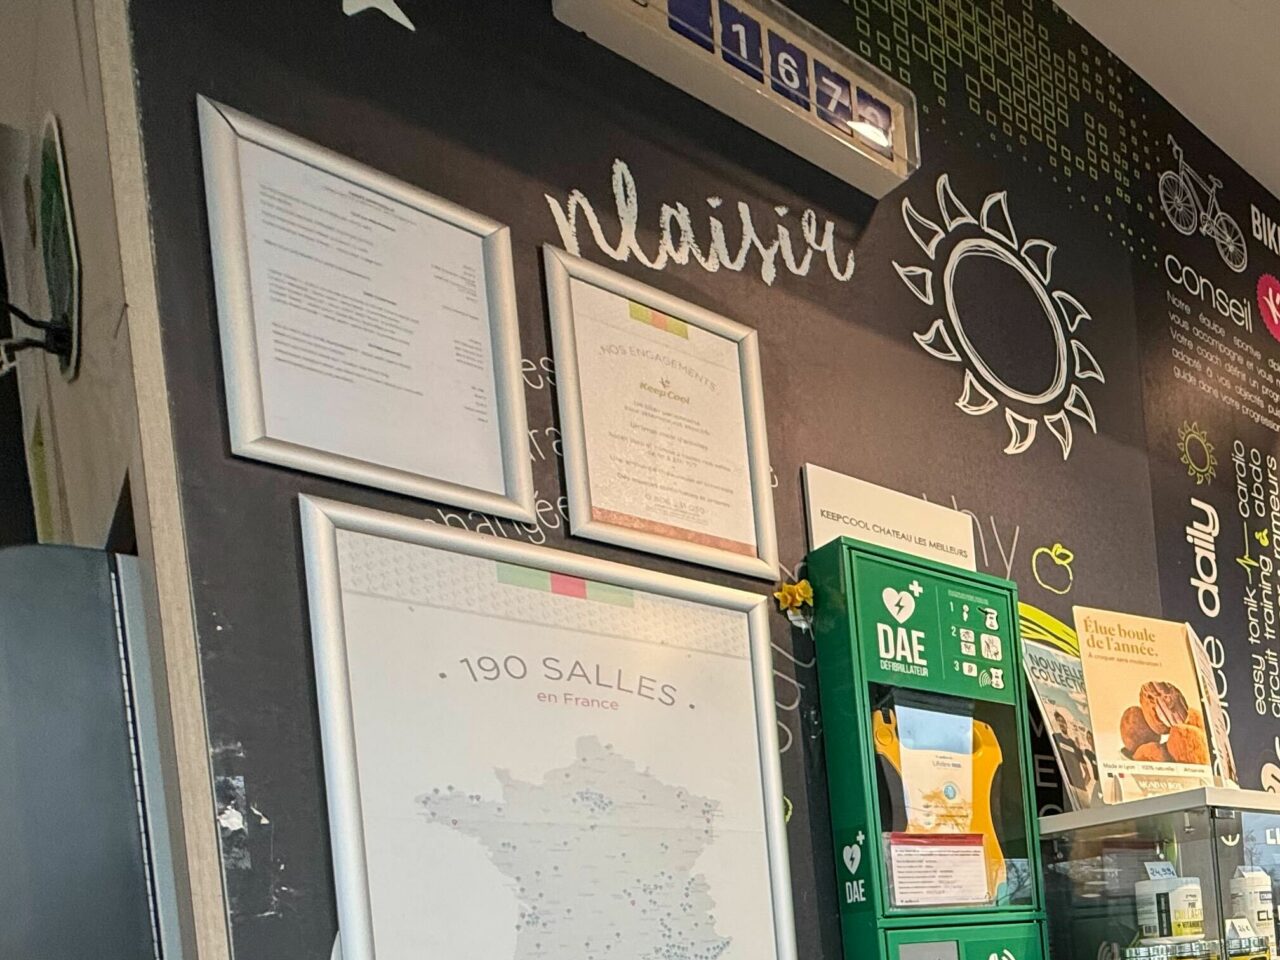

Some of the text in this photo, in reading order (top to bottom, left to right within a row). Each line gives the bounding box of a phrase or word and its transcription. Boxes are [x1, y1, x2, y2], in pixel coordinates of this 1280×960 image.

[1165, 254, 1252, 333] conseil
[1167, 290, 1191, 314] Notre
[1168, 311, 1244, 364] vous accompagne
[1170, 326, 1194, 350] Votre
[1196, 346, 1222, 367] coach
[600, 344, 717, 393] NOS ENGAGEMENTS
[1220, 391, 1241, 411] votre
[1249, 448, 1266, 518] abdo
[820, 509, 968, 559] KEEPCOOL CHATEAU LES MEILLEURS
[1185, 497, 1221, 619] daily
[1231, 439, 1267, 716] easy tonik cardio
[1258, 553, 1278, 641] training
[877, 623, 928, 666] DAE
[951, 626, 957, 637] 2
[1083, 616, 1156, 643] Élue boule
[1086, 636, 1159, 658] de l'année.
[459, 654, 679, 707] 190 SALLES
[880, 659, 929, 678] DÉFIBRILLATEUR
[953, 660, 960, 671] 3
[536, 690, 620, 711] en France
[1124, 764, 1136, 772] Lyon
[845, 880, 867, 904] DAE
